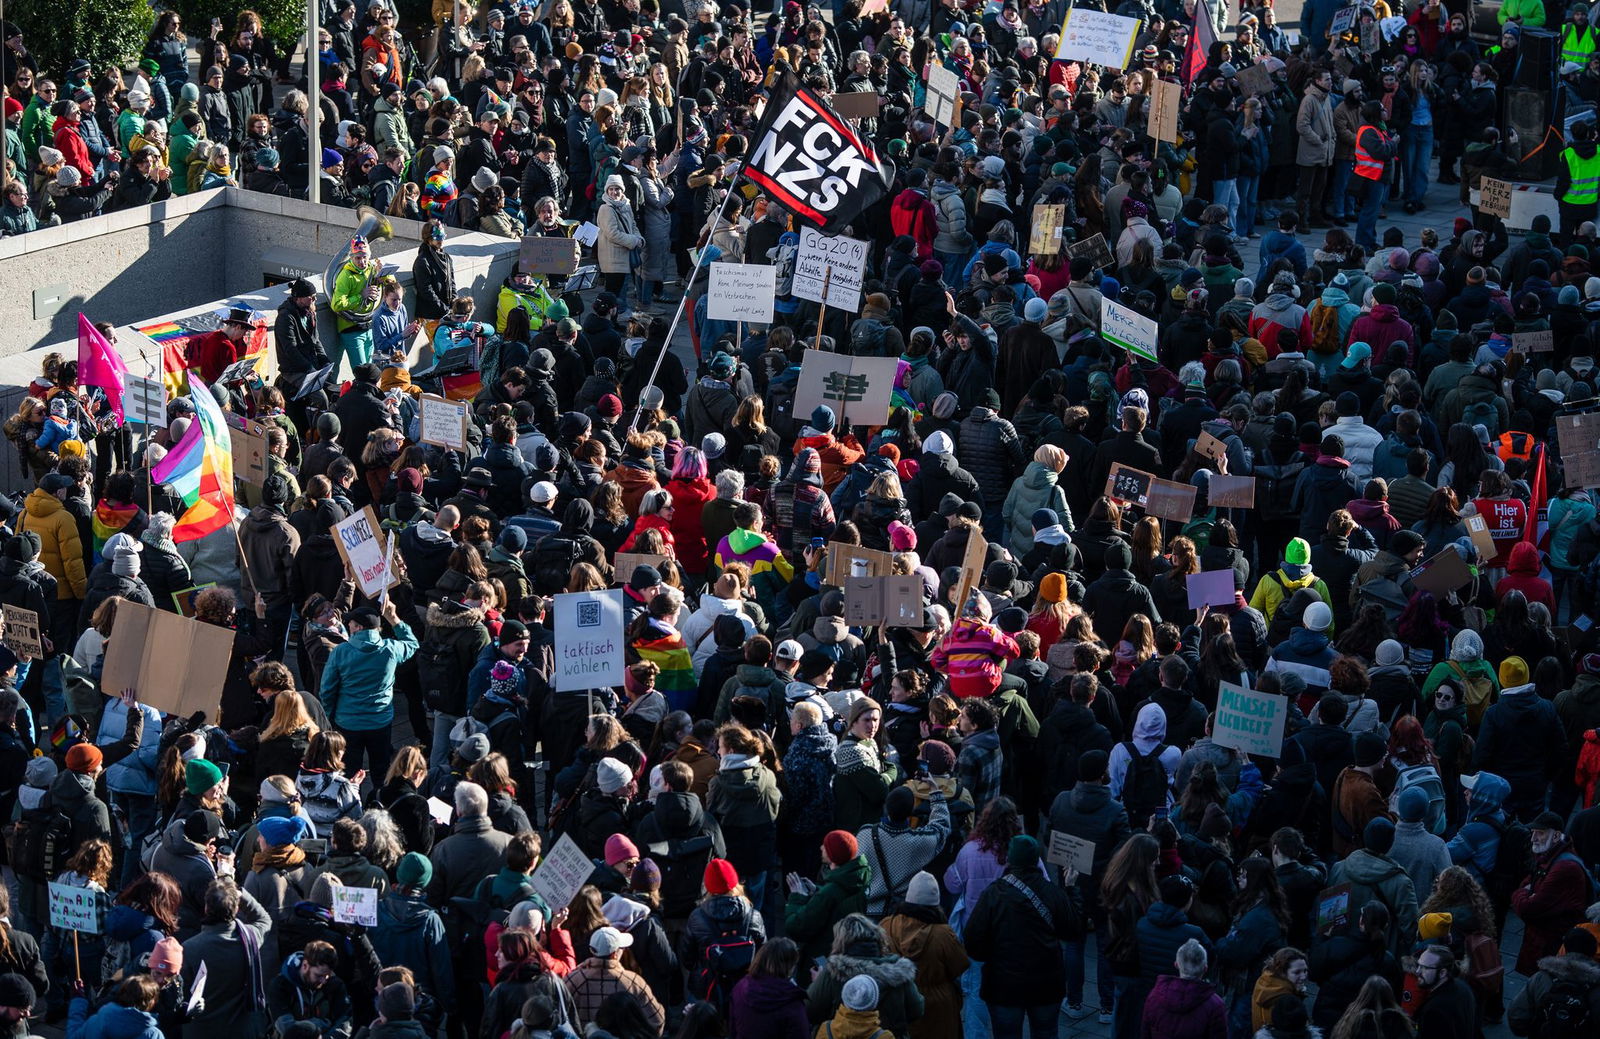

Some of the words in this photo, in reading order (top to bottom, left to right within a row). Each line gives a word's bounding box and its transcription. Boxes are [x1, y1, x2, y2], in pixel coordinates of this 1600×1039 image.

[772, 96, 878, 188] FCK
[750, 129, 848, 211] NZS
[1487, 179, 1505, 189] KEIN
[1483, 186, 1510, 199] MERZ
[1489, 195, 1499, 203] IM
[851, 244, 862, 260] (4)
[1104, 322, 1118, 335] DU
[1120, 330, 1155, 356] LOSER
[1494, 504, 1518, 516] Hier
[1500, 516, 1514, 528] ist
[341, 517, 373, 551] SCHMERZ
[564, 638, 614, 659] taktisch
